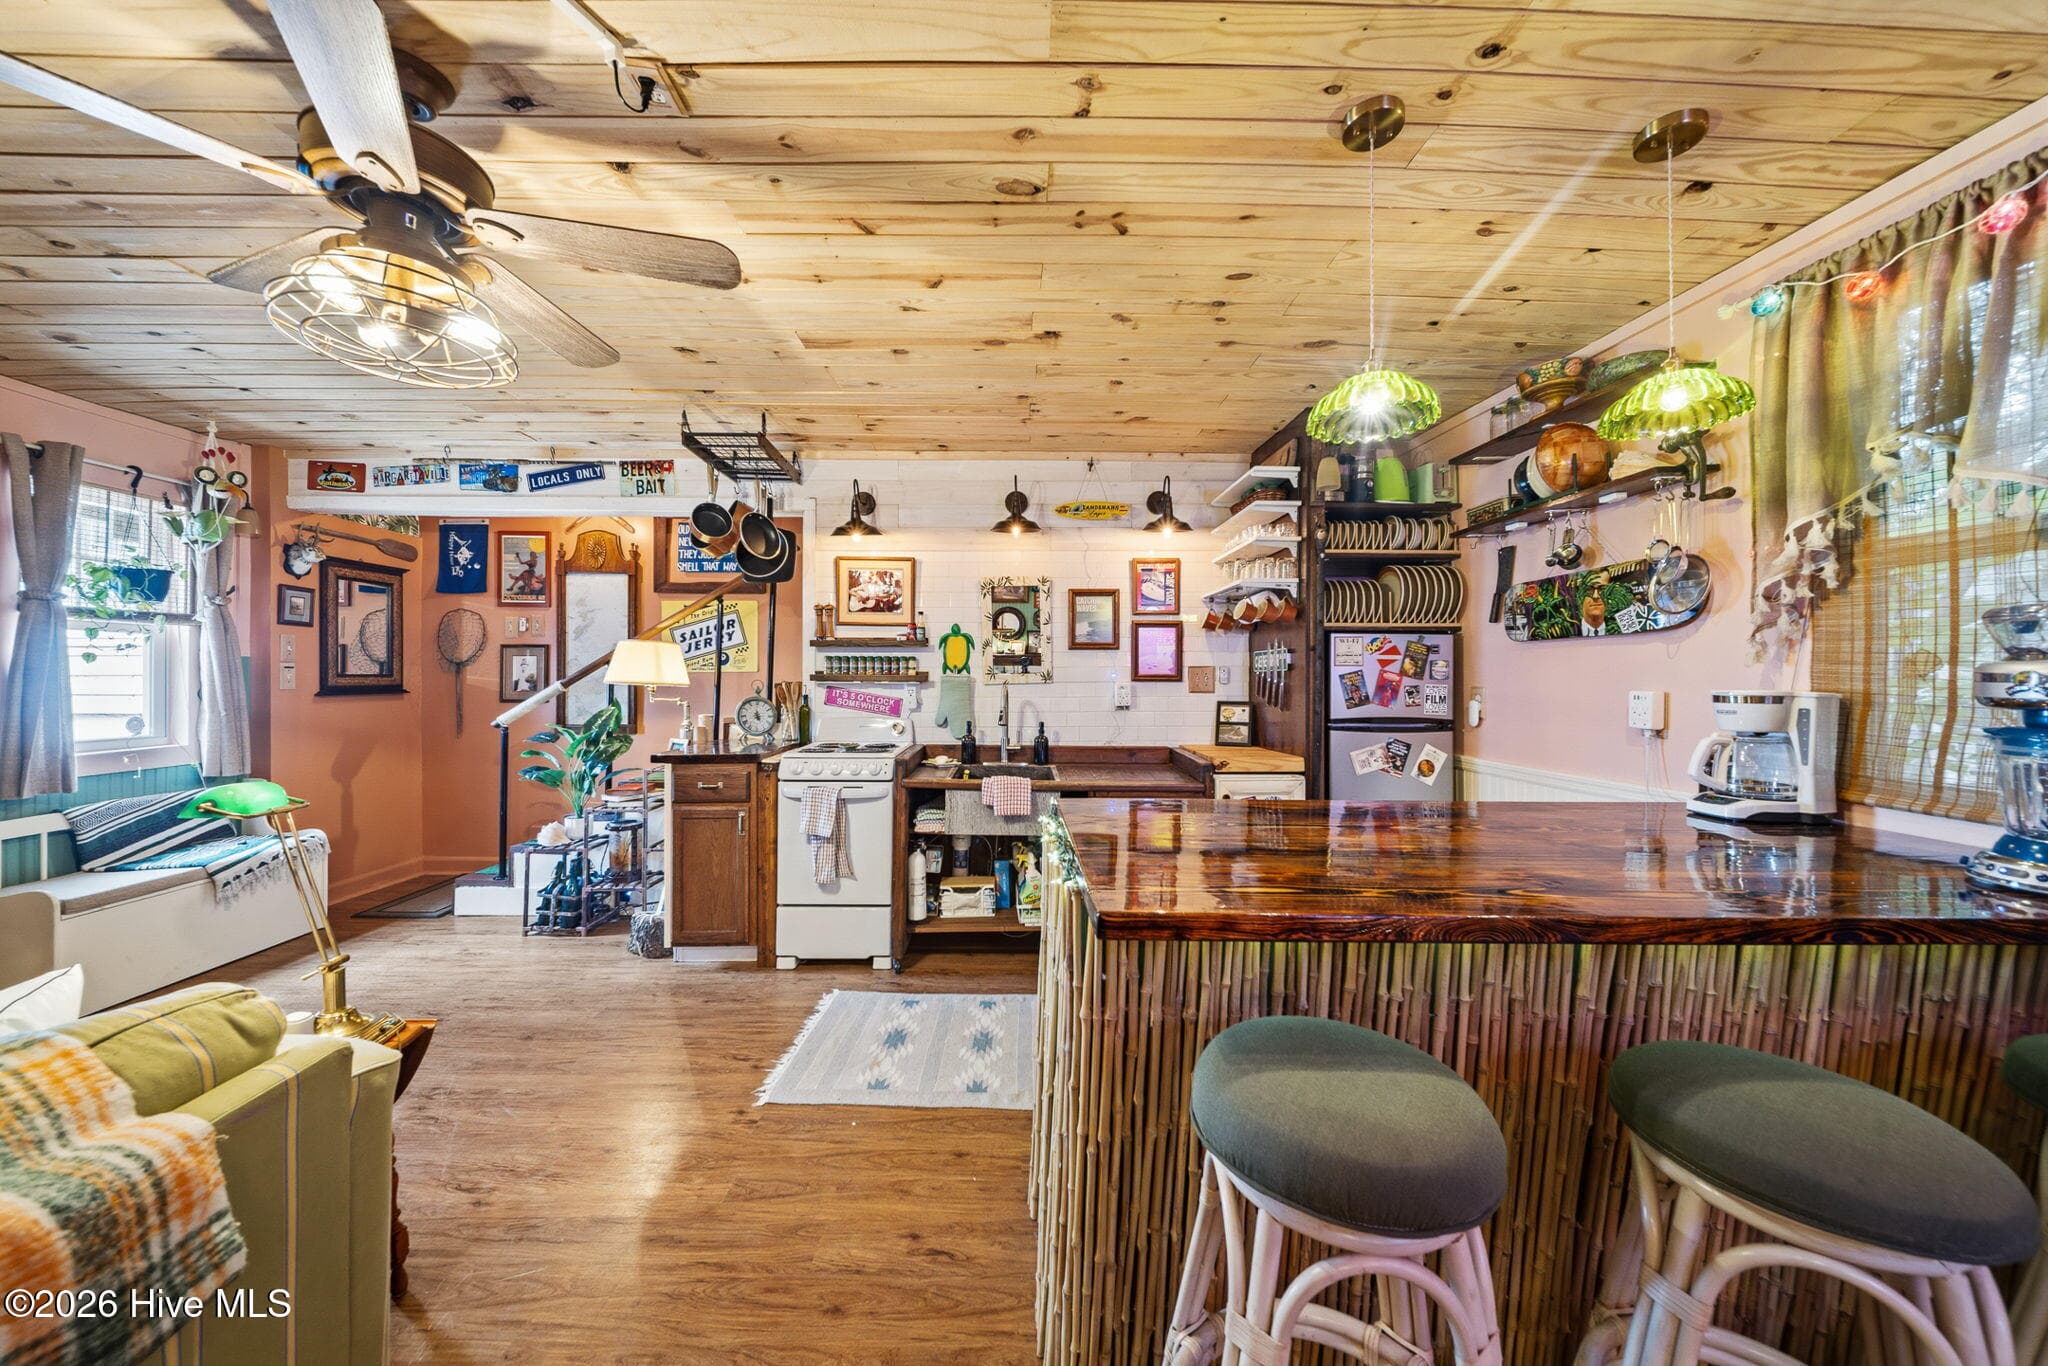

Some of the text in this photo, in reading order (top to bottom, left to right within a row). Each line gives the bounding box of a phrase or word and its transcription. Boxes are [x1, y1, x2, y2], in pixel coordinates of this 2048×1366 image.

[531, 466, 601, 488] LOCALS ONLY
[621, 464, 653, 477] BEER
[636, 478, 665, 495] BAIT
[678, 549, 698, 559] THEY
[678, 561, 738, 572] SMELL THAT WAY
[684, 630, 736, 654] JERY
[832, 689, 848, 699] IT'S
[857, 693, 895, 707] O'CLOCK
[836, 697, 891, 712] SOMEWHERE
[1425, 694, 1447, 705] FILM
